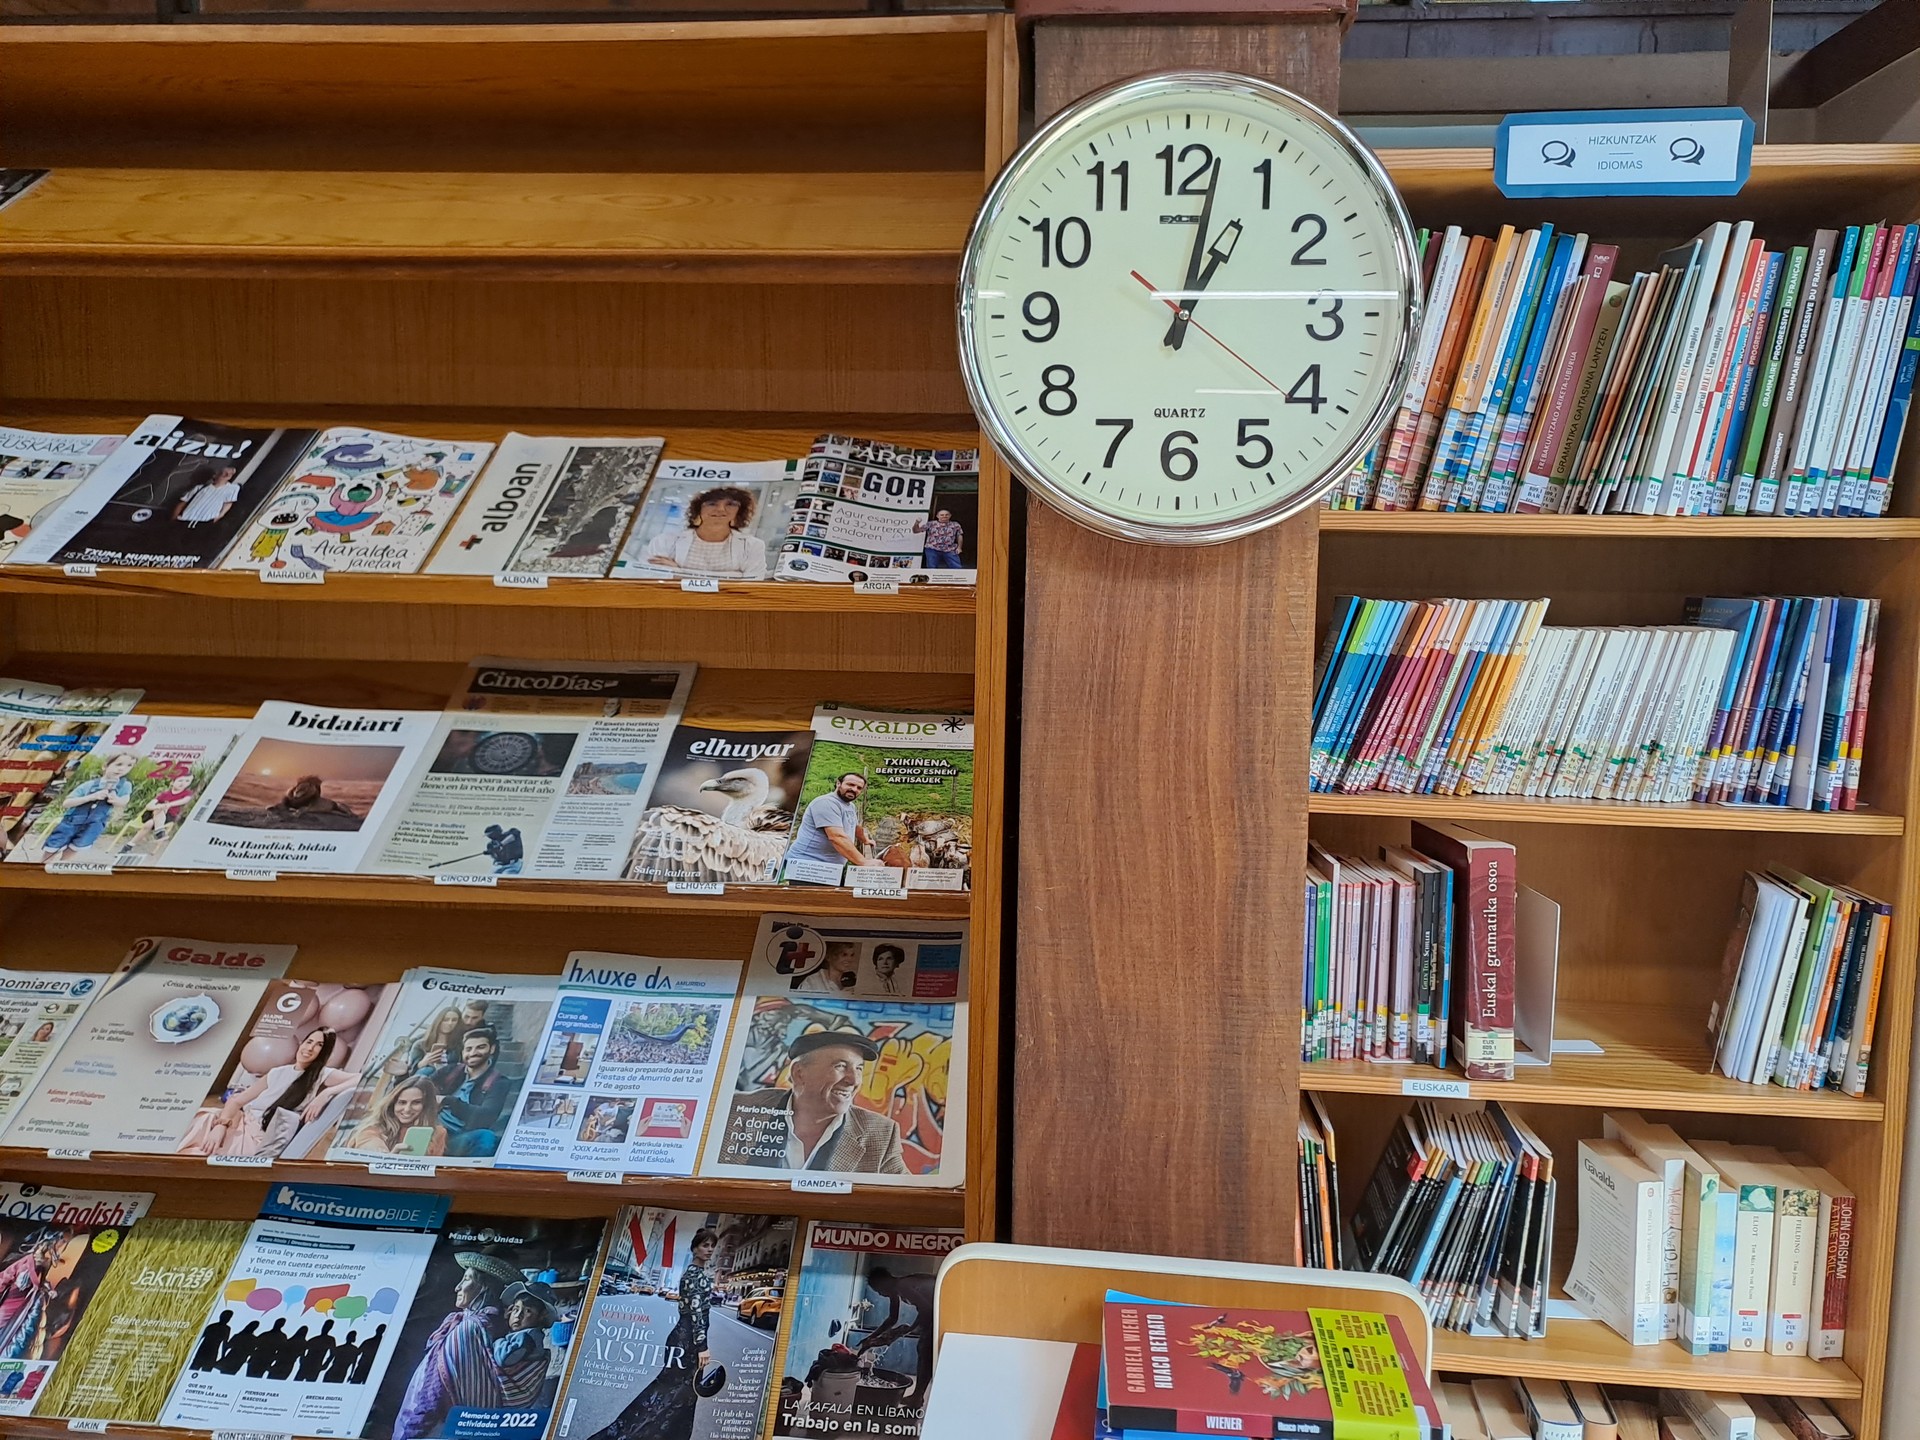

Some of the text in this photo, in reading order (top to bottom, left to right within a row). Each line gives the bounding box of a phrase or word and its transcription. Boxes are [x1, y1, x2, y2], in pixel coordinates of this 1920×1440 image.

[1588, 134, 1657, 146] HIZKUNTZAK
[1155, 143, 1213, 196] 12
[1598, 160, 1643, 170] IDIOMAS
[1087, 160, 1129, 211] 11
[1253, 158, 1272, 210] 1
[1159, 215, 1201, 224] EXCE
[1032, 216, 1092, 268] 10
[1290, 213, 1328, 265] 2
[1846, 234, 1855, 255] English
[1864, 232, 1873, 254] English
[1876, 236, 1885, 257] English
[1891, 232, 1901, 255] English
[1905, 232, 1914, 254] English
[1753, 260, 1767, 297] FRANÇAIS
[1021, 290, 1060, 342] 9
[1305, 288, 1344, 341] 3
[1762, 255, 1803, 407] GRAMMAIRE PROGRESSIVE DU FRANÇAIS
[1786, 248, 1826, 401] GRAMMAIRE PROGRESSIVE DU FRANÇAIS
[1739, 262, 1779, 411] GRAMMAIRE PROGRESSIVE FRANÇAIS
[1038, 364, 1078, 416] 8
[1284, 363, 1328, 414] 4
[1726, 366, 1741, 410] GRAMMAIRE
[1557, 327, 1609, 474] GRAMATIKA GAITASUNA LANTZEN
[1154, 407, 1206, 419] QUARTZ
[134, 430, 252, 459] aizu!
[1095, 418, 1134, 468] 7
[1235, 418, 1274, 469] 5
[1537, 412, 1560, 470] TREBAKUNTZAKO
[857, 448, 941, 469] ARGIA
[1160, 430, 1199, 481] 6
[863, 472, 926, 498] GOR
[482, 463, 542, 533] alboan
[834, 516, 911, 534] du 32 urteren
[836, 508, 909, 526] Agur esango
[832, 525, 883, 541] ondoren
[85, 548, 201, 563] TXUMA MURUGARREN
[312, 540, 408, 560] Aiaraldea
[70, 566, 90, 574] AIZU
[267, 571, 317, 579] AIARALDEA
[502, 576, 540, 584] ALBOAN
[688, 579, 712, 588] ALEA
[478, 671, 604, 691] CincoDías
[288, 711, 404, 733] bidaiari
[690, 737, 795, 763] elhuyar
[147, 761, 193, 779] 25
[875, 767, 922, 775] BERTOKO
[884, 758, 951, 768] TXIKIÑENA,
[420, 782, 556, 794] lleno recta final del año
[444, 775, 478, 783] valores
[479, 777, 502, 785] para
[503, 777, 539, 785] acertar
[208, 836, 337, 852] Bost Handiak, bidaia
[226, 850, 308, 861] bakar batean
[664, 866, 702, 878] kultura
[675, 882, 718, 890] ELHUYAR
[861, 888, 902, 897] ETXALDE
[1482, 860, 1501, 1018] Euskal gramatika osoa
[167, 947, 266, 967] Galde
[439, 980, 506, 997] Gazteberri
[555, 1019, 602, 1030] programación
[557, 1012, 577, 1020] Curso
[595, 1073, 625, 1081] Fiestas
[639, 1074, 670, 1082] Amurrio
[635, 1066, 691, 1076] preparado para
[616, 1083, 641, 1091] agosto
[1412, 1082, 1459, 1093] EUSKARA
[736, 1105, 794, 1117] Mario Delgado
[746, 1116, 785, 1131] donde
[513, 1135, 549, 1144] Concierto
[730, 1130, 784, 1145] nos lleve
[54, 1149, 84, 1157] GALDE
[510, 1143, 550, 1151] Campanas
[591, 1146, 619, 1154] Artzain
[630, 1148, 669, 1156] Amurrioko
[727, 1143, 787, 1159] el océano
[570, 1153, 593, 1162] Eguna
[628, 1155, 675, 1164] Udal Eskolak
[573, 1171, 602, 1179] HAUXE
[1584, 1158, 1615, 1191] Gavalda
[797, 1180, 837, 1188] IGANDEA
[291, 1196, 421, 1222] kontsumoBIDE
[448, 1231, 524, 1244] Manos Unidas
[814, 1228, 965, 1250] MUNDO NEGRO
[1836, 1204, 1852, 1279] JOHN GRISHAM
[284, 1249, 294, 1258] ley
[296, 1250, 329, 1260] moderna
[256, 1256, 366, 1272] tiene cuenta especialmente
[131, 1267, 183, 1287] Jakin
[264, 1268, 297, 1278] personas
[299, 1270, 314, 1278] más
[142, 1318, 191, 1328] berrikuntza
[594, 1319, 655, 1341] Sophie
[1121, 1308, 1141, 1342] WIENER
[585, 1338, 687, 1369] AUSTER
[1146, 1313, 1174, 1389] HUACO RETRATO
[612, 1365, 648, 1375] sofisticada
[1124, 1346, 1146, 1394] GABRIELA
[460, 1411, 491, 1421] Memoria
[784, 1400, 925, 1419] LA KAFALA EN LÍBANO
[74, 1421, 99, 1430] JAKIN
[457, 1412, 537, 1429] actividades 2022
[782, 1413, 839, 1431] Trabajo
[843, 1419, 862, 1432] en
[866, 1419, 880, 1433] la
[1206, 1415, 1243, 1431] WIENER
[1297, 1423, 1320, 1435] retrato
